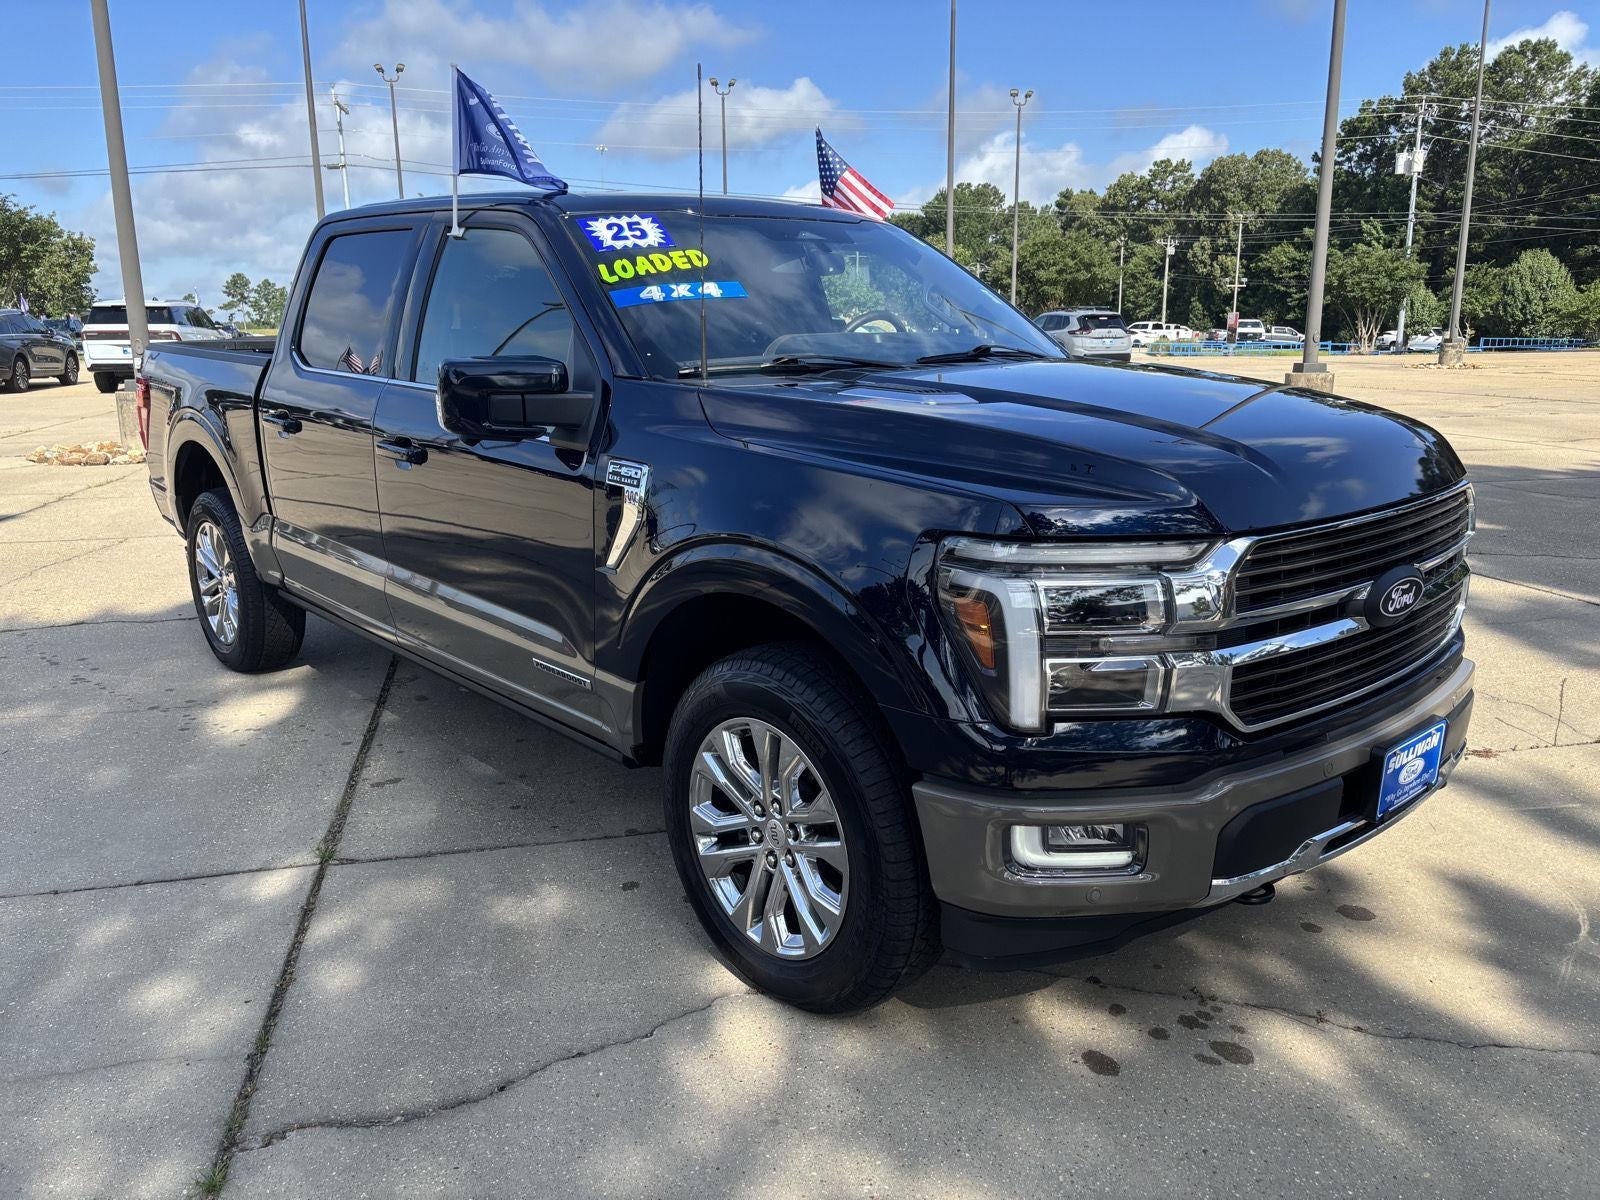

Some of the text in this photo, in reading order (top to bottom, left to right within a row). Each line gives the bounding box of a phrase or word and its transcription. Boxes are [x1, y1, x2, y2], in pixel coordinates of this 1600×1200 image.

[606, 221, 648, 241] 25
[598, 249, 709, 283] LOADED
[1388, 583, 1416, 612] Ford
